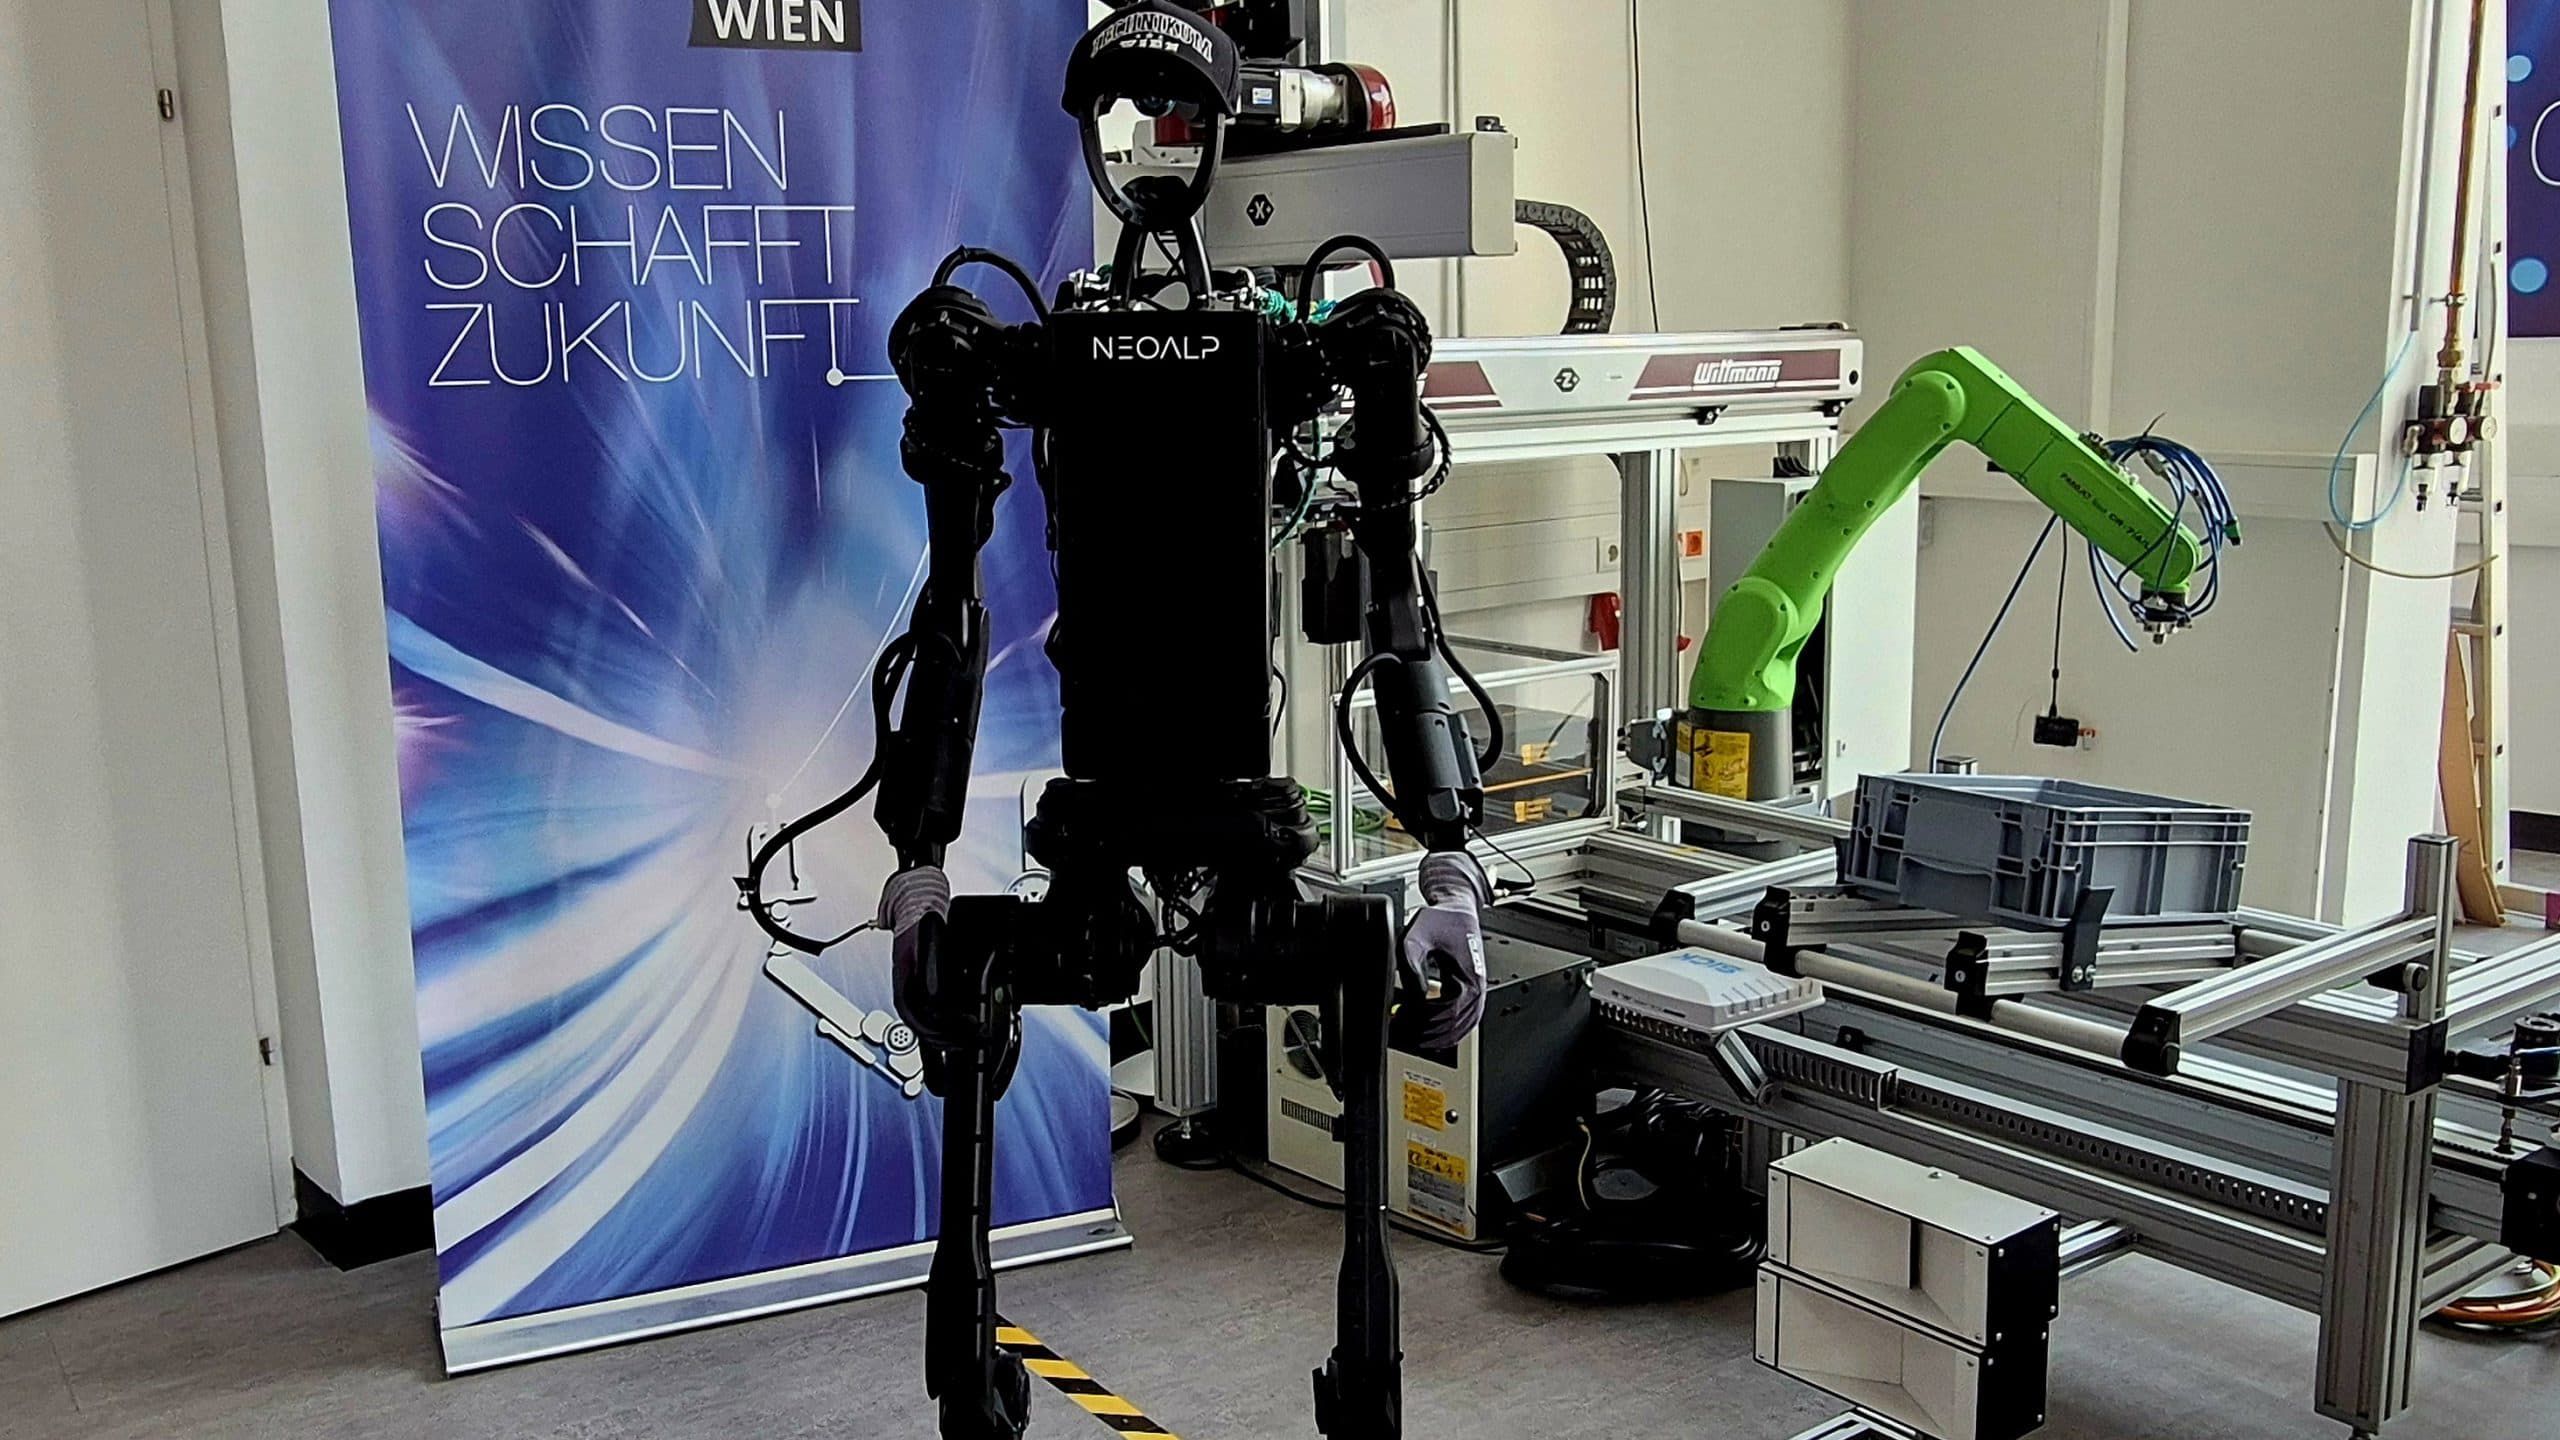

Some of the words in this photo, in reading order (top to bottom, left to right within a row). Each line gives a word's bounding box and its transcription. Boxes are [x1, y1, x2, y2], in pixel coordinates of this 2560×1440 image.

[708, 0, 845, 43] WIEN
[406, 103, 787, 190] WISSEN
[422, 203, 856, 289] SCHAFFT
[425, 298, 860, 387] ZUKUNFT
